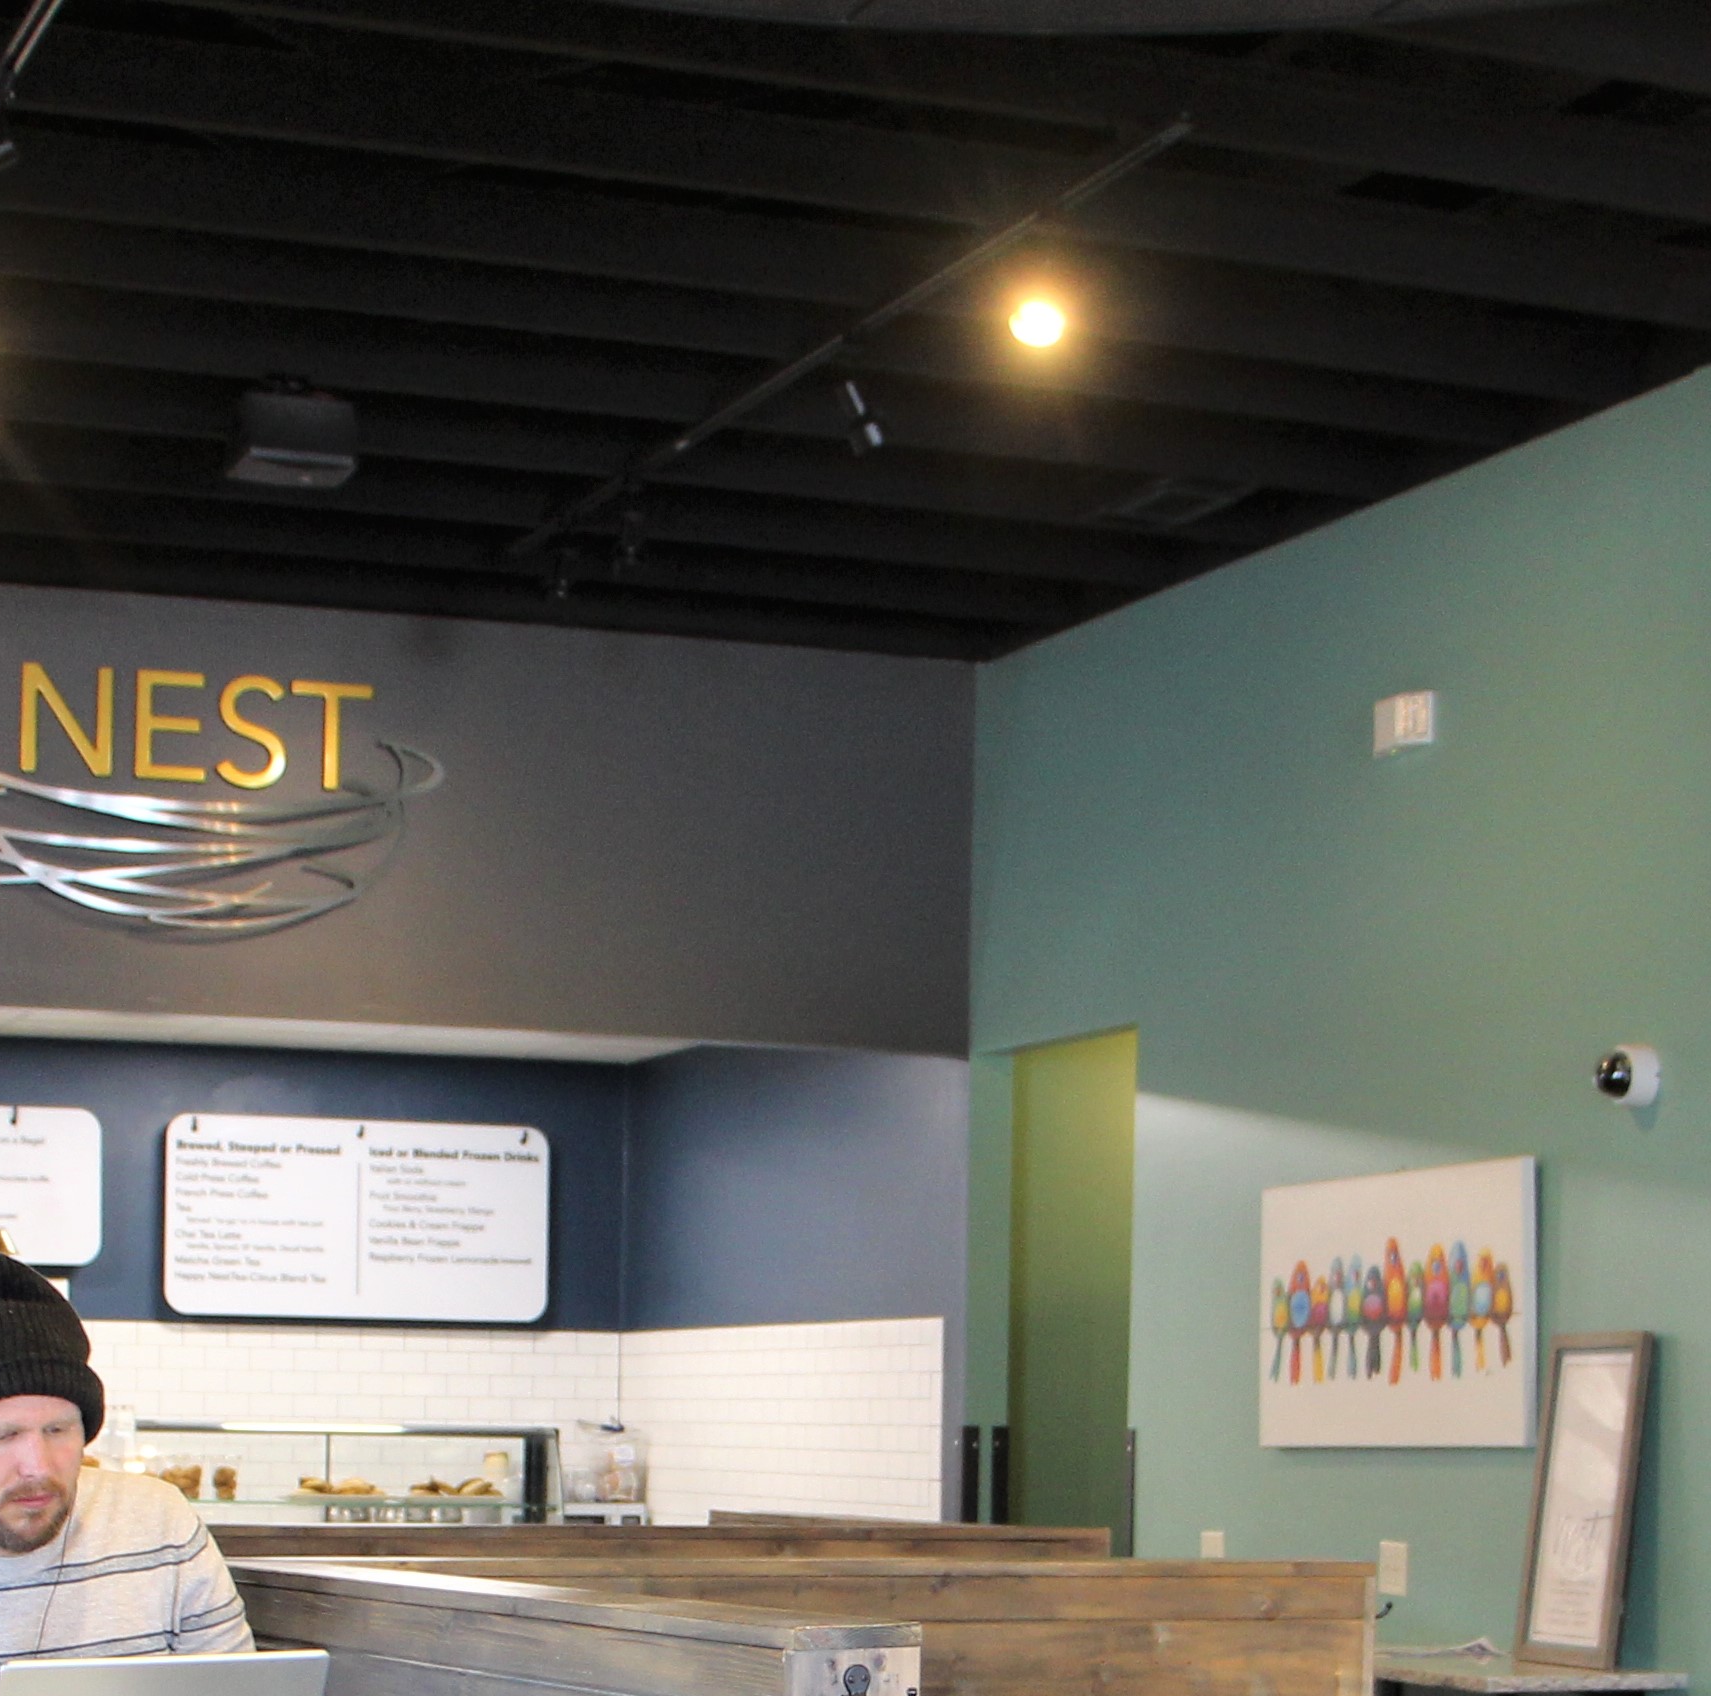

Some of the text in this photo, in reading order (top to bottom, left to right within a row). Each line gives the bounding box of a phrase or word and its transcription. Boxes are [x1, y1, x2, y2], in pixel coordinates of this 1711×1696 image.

[19, 662, 374, 791] NEST
[176, 1139, 341, 1156] Brewed, Steeped or Pressed
[369, 1147, 540, 1163] Iced or Blended Frozen Drinks
[228, 1173, 260, 1184] Coffee
[237, 1188, 269, 1199] Coffee
